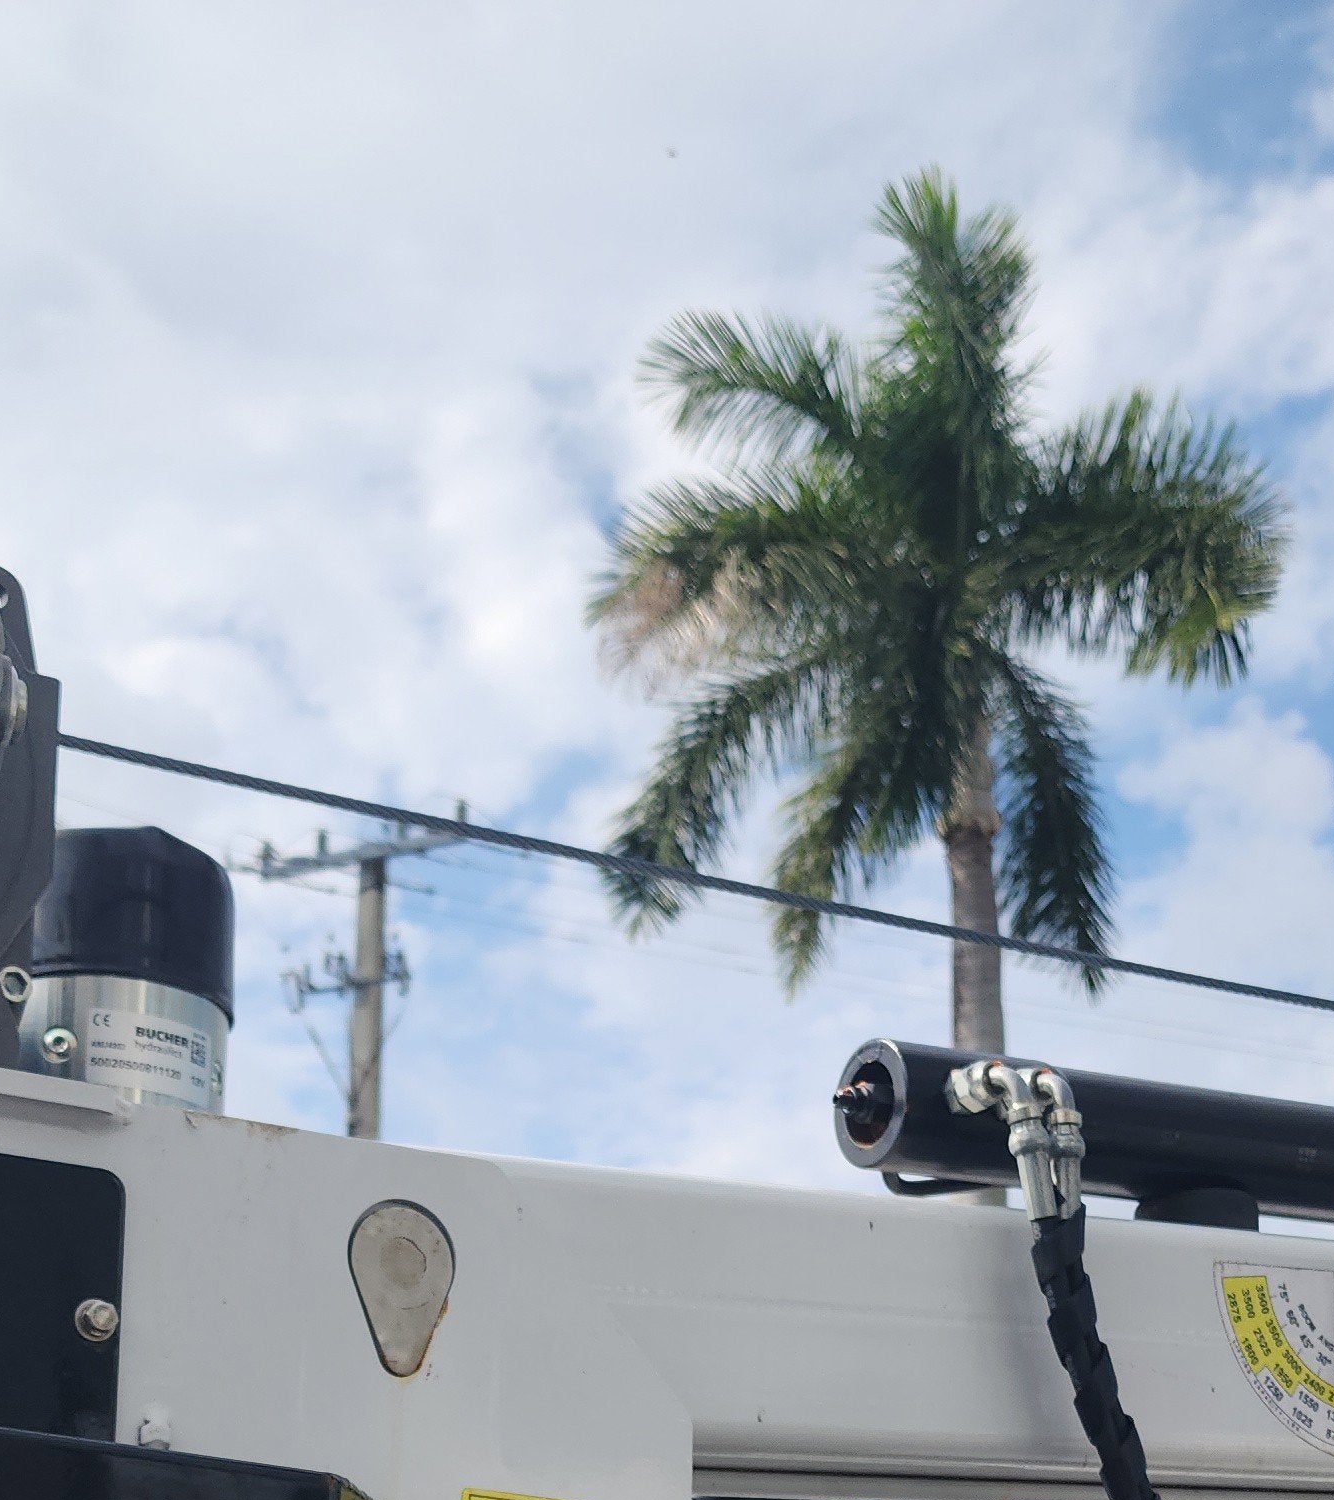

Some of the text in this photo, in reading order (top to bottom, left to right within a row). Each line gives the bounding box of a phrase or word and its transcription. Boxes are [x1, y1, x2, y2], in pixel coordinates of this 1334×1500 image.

[135, 1026, 189, 1048] BUCHER
[1226, 1292, 1242, 1324] 2875
[1241, 1337, 1259, 1366] 1800
[1253, 1328, 1272, 1358] 2525
[1255, 1285, 1270, 1315] 3500
[1265, 1318, 1283, 1348] 3500
[1281, 1349, 1303, 1376] 3000
[1302, 1373, 1325, 1397] 2400
